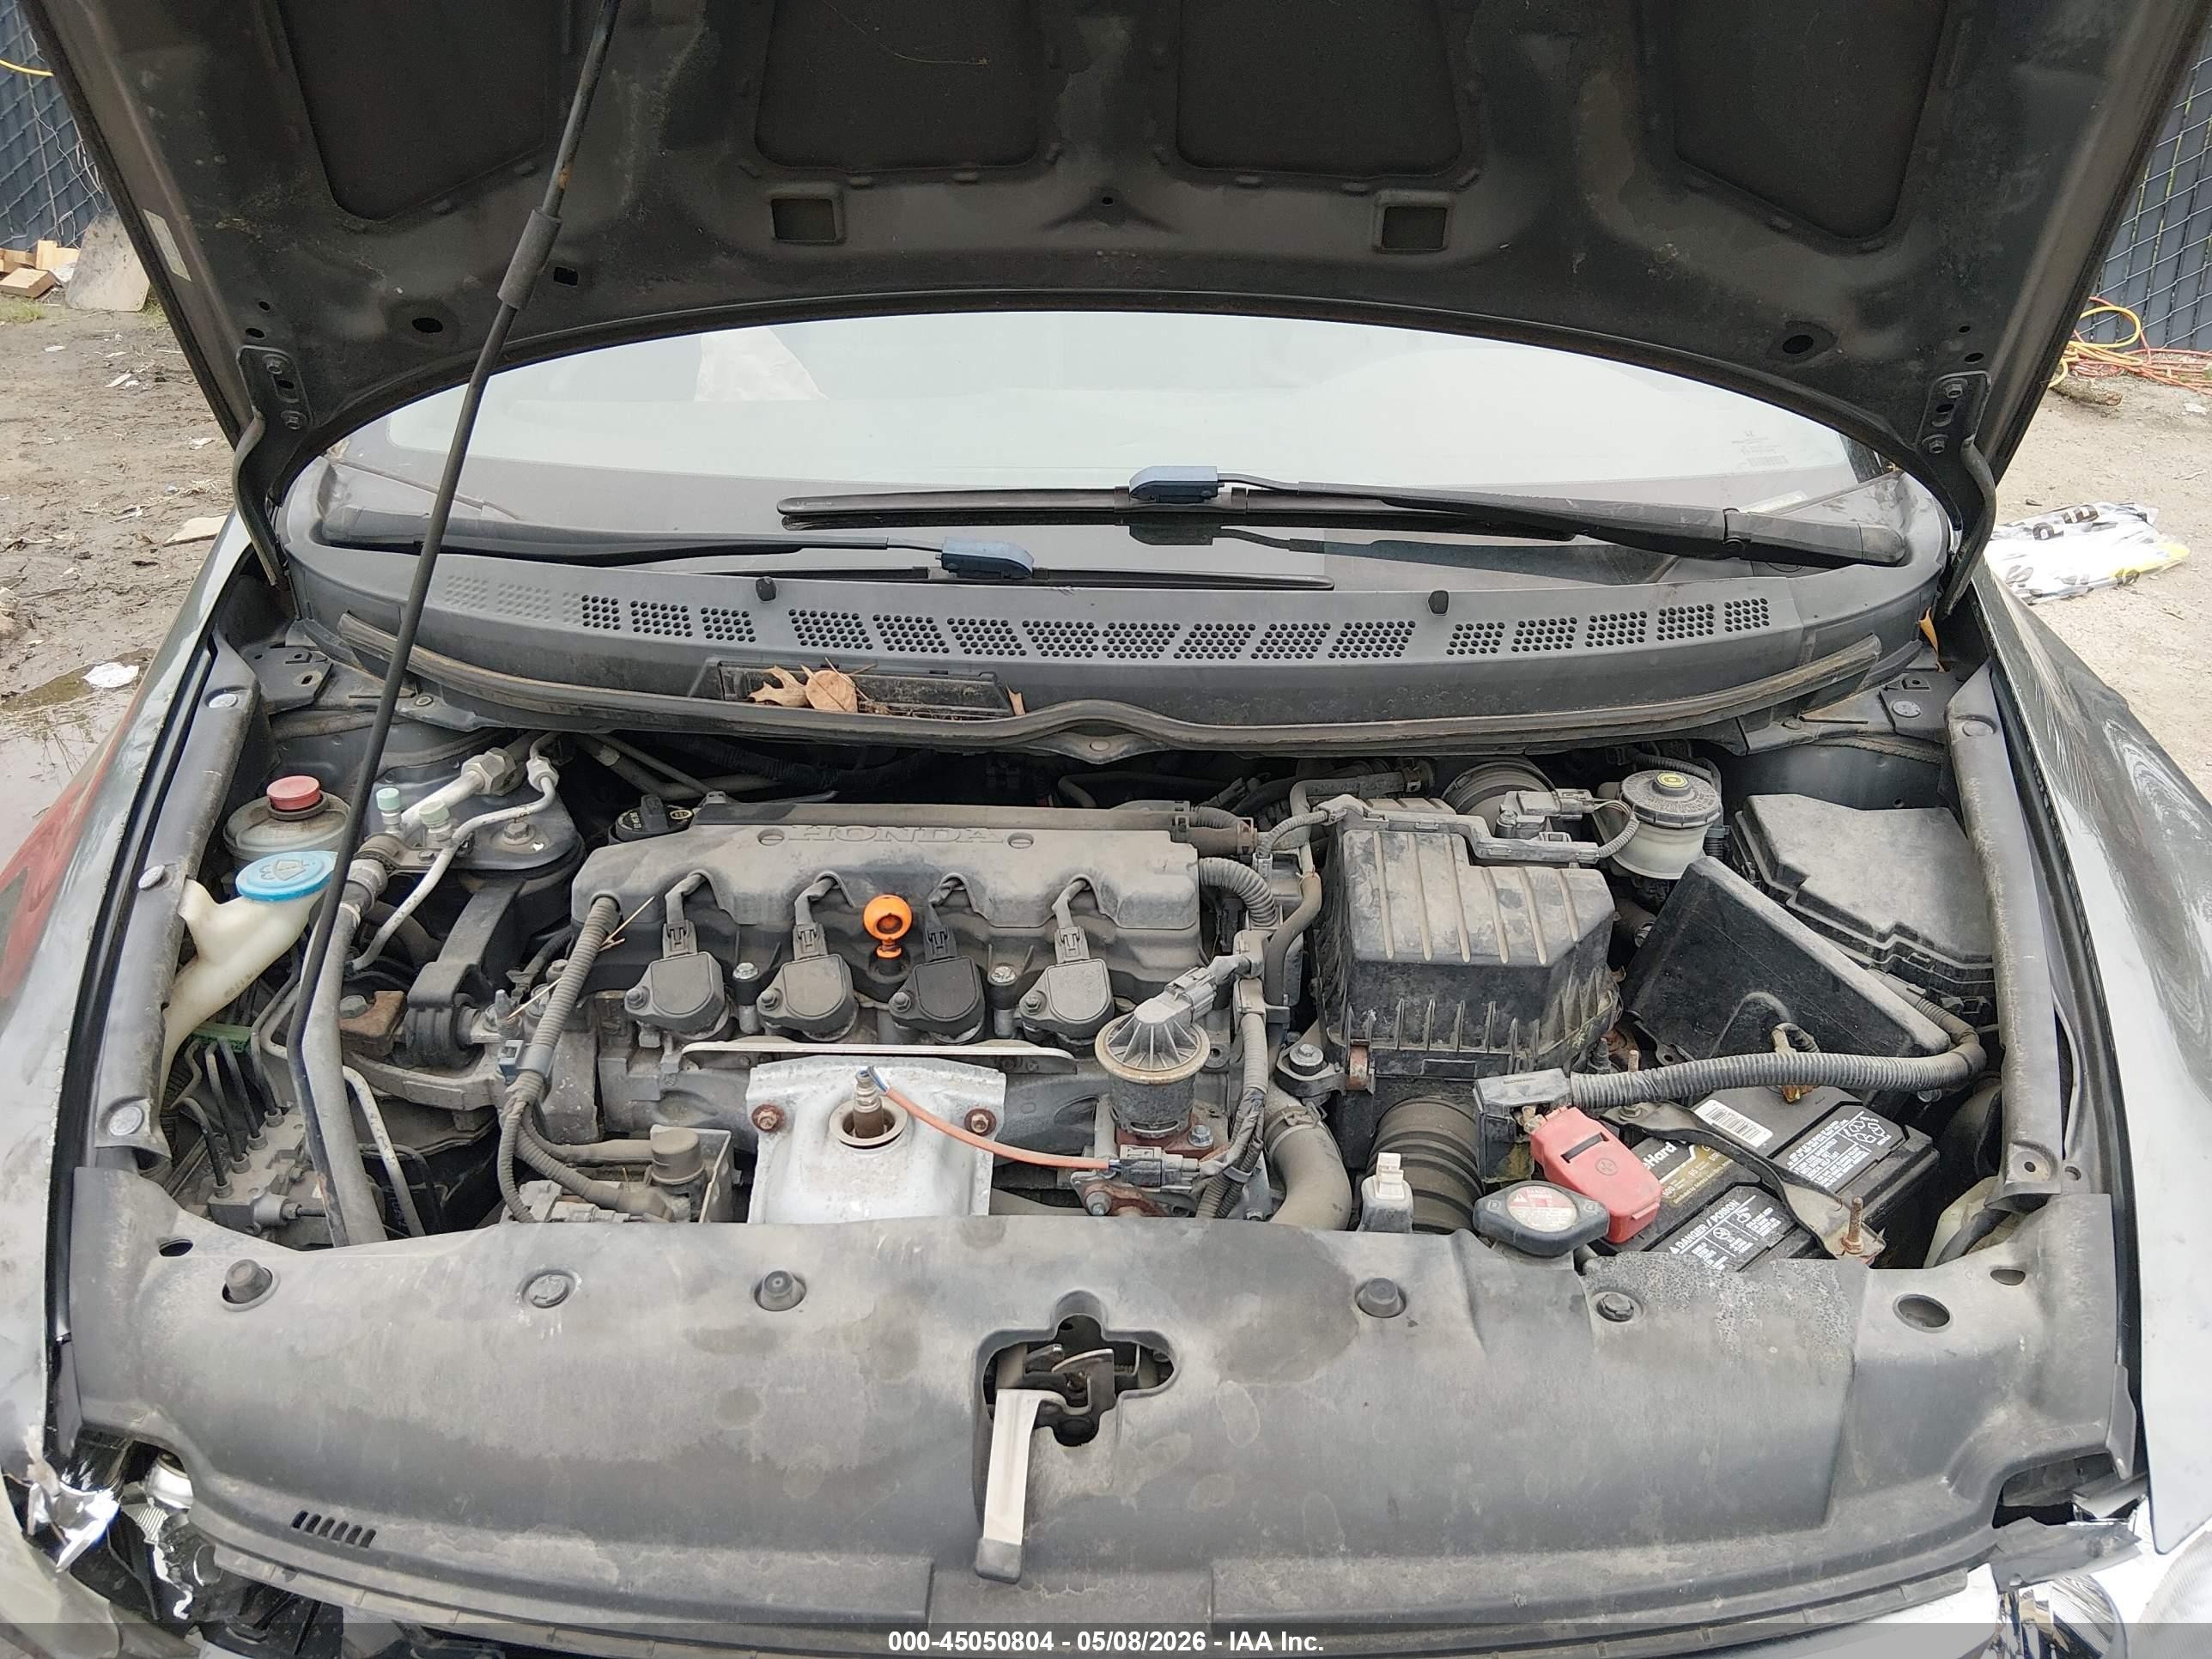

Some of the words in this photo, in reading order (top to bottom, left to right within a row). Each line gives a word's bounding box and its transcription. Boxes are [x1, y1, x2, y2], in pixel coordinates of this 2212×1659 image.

[788, 825, 1004, 843] HONDA
[1642, 1141, 1677, 1170] eHard
[1674, 1224, 1709, 1250] DANGER
[1710, 1200, 1740, 1222] POISON
